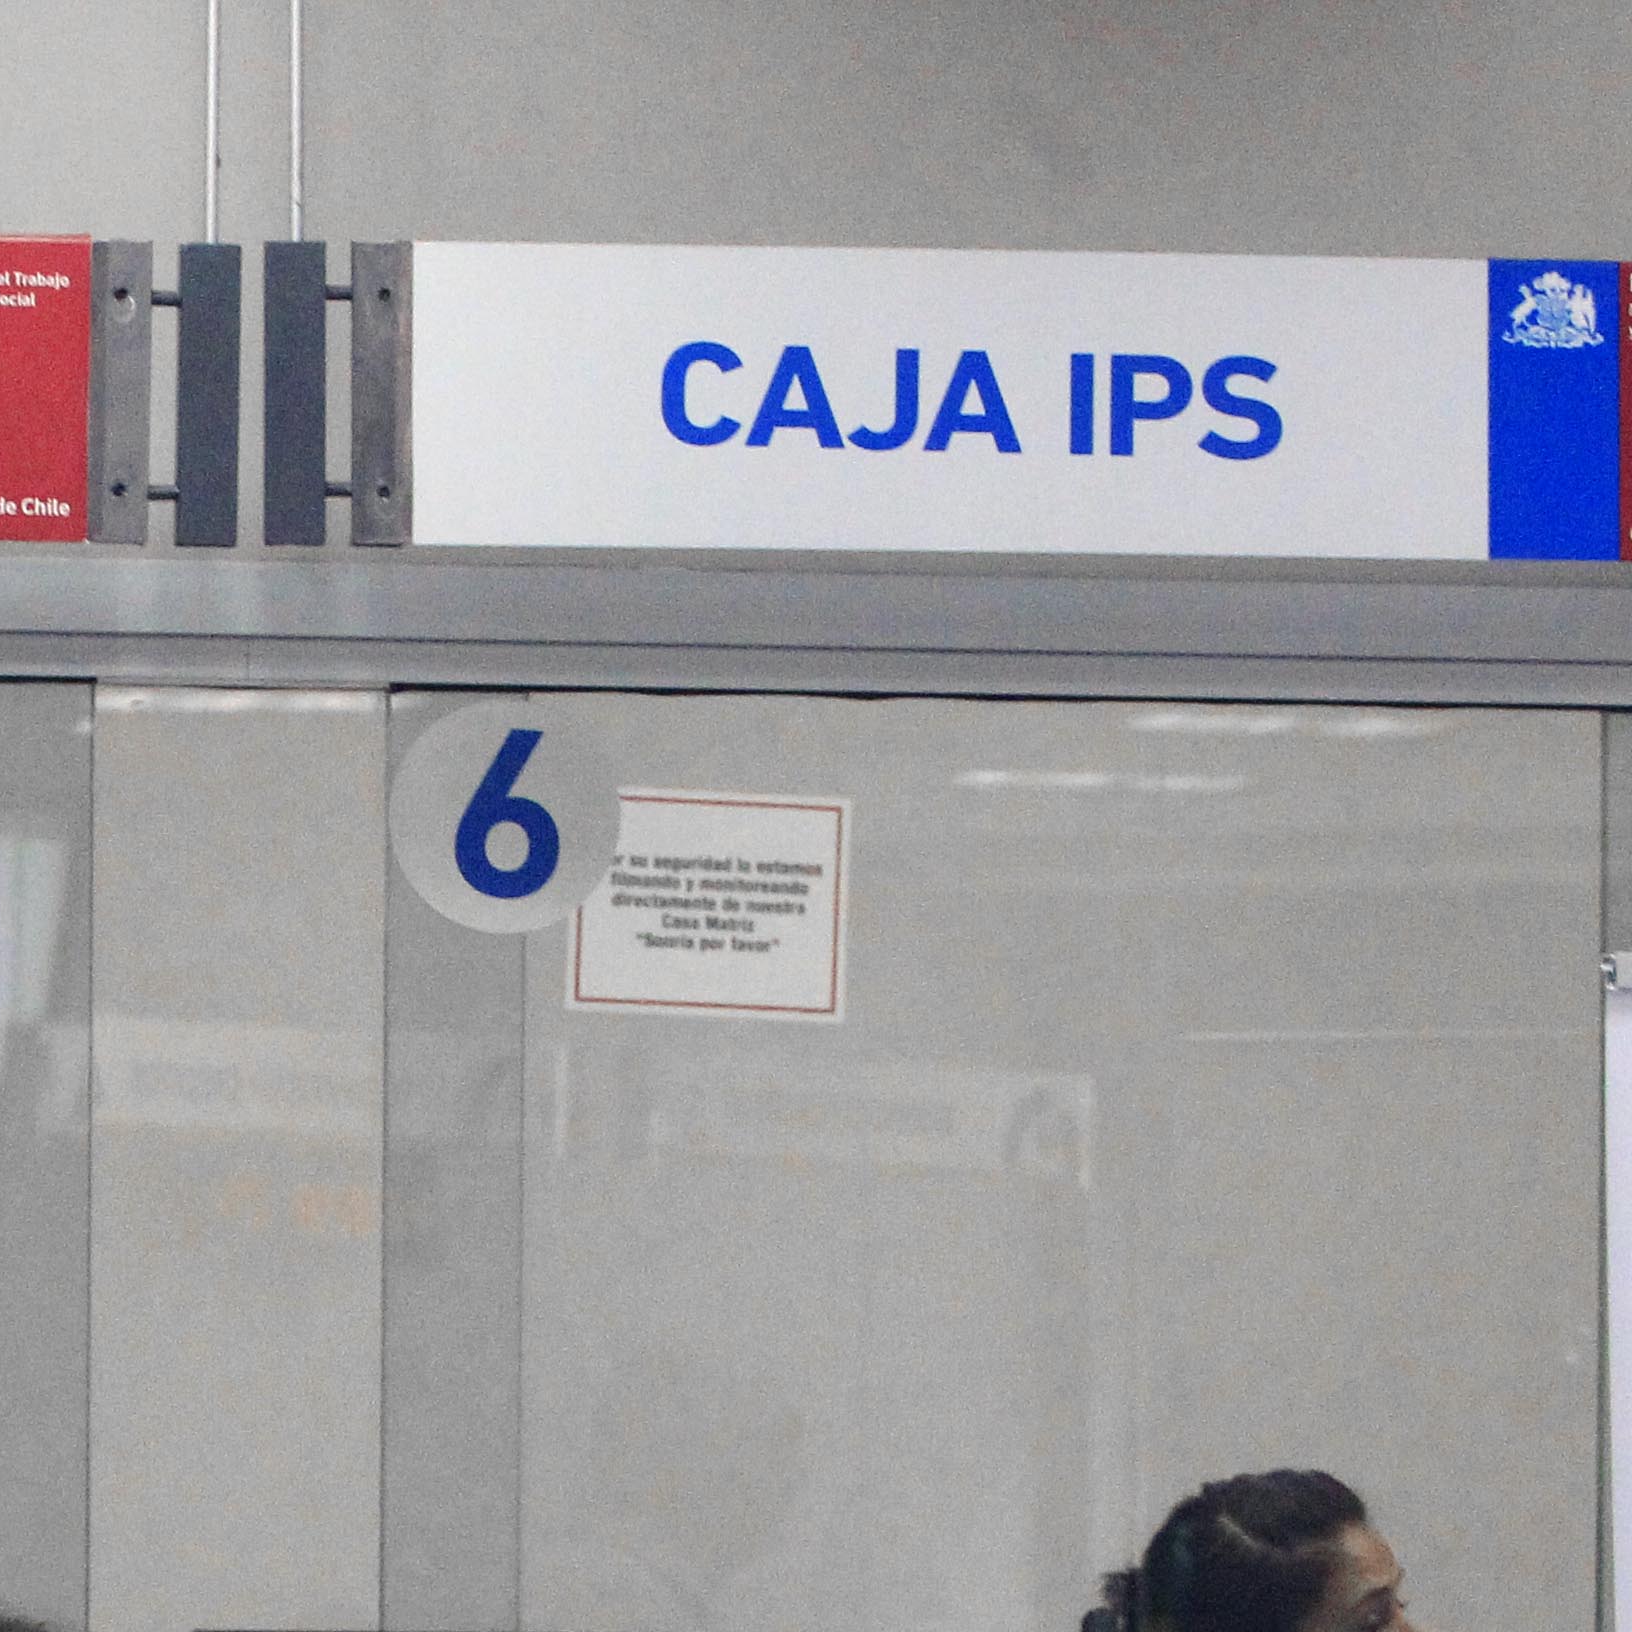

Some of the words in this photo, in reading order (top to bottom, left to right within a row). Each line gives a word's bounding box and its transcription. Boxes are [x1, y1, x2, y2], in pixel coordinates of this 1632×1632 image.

[13, 271, 70, 291] Trabajo
[662, 341, 1023, 454] CAJA
[1070, 353, 1284, 461] IPS
[21, 497, 70, 517] Chile
[455, 729, 561, 900] 6
